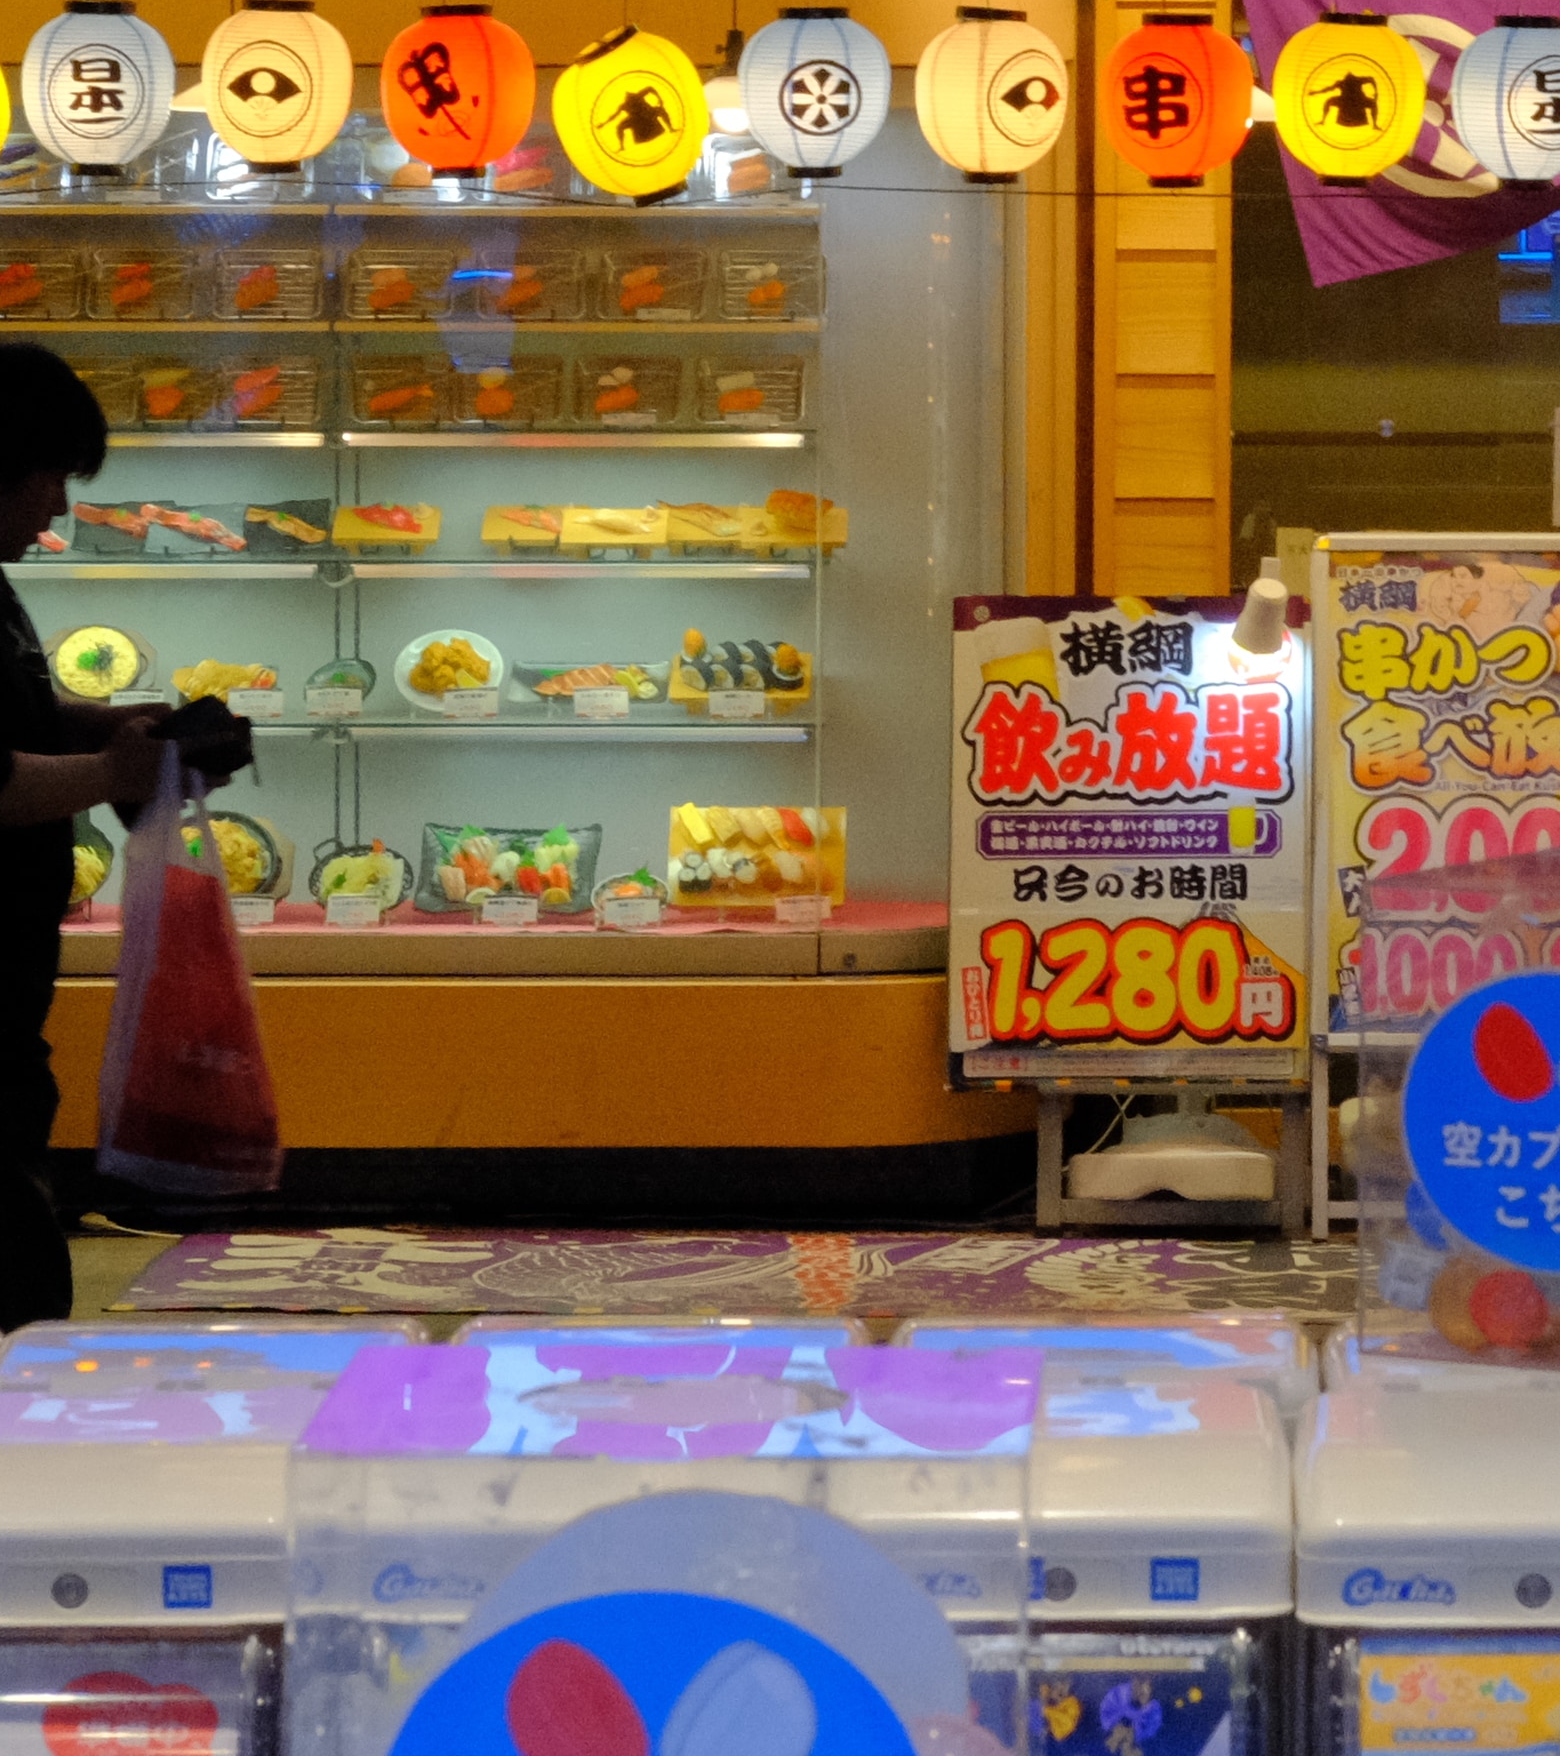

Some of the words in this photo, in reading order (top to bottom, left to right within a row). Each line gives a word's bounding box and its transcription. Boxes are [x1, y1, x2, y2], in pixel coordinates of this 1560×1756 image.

[69, 59, 126, 130] 日本一
[1060, 621, 1193, 676] 横綱
[1337, 621, 1554, 702] 串かつ
[973, 689, 1284, 793] 飲み放題
[1012, 863, 1249, 903] 只今のお時間
